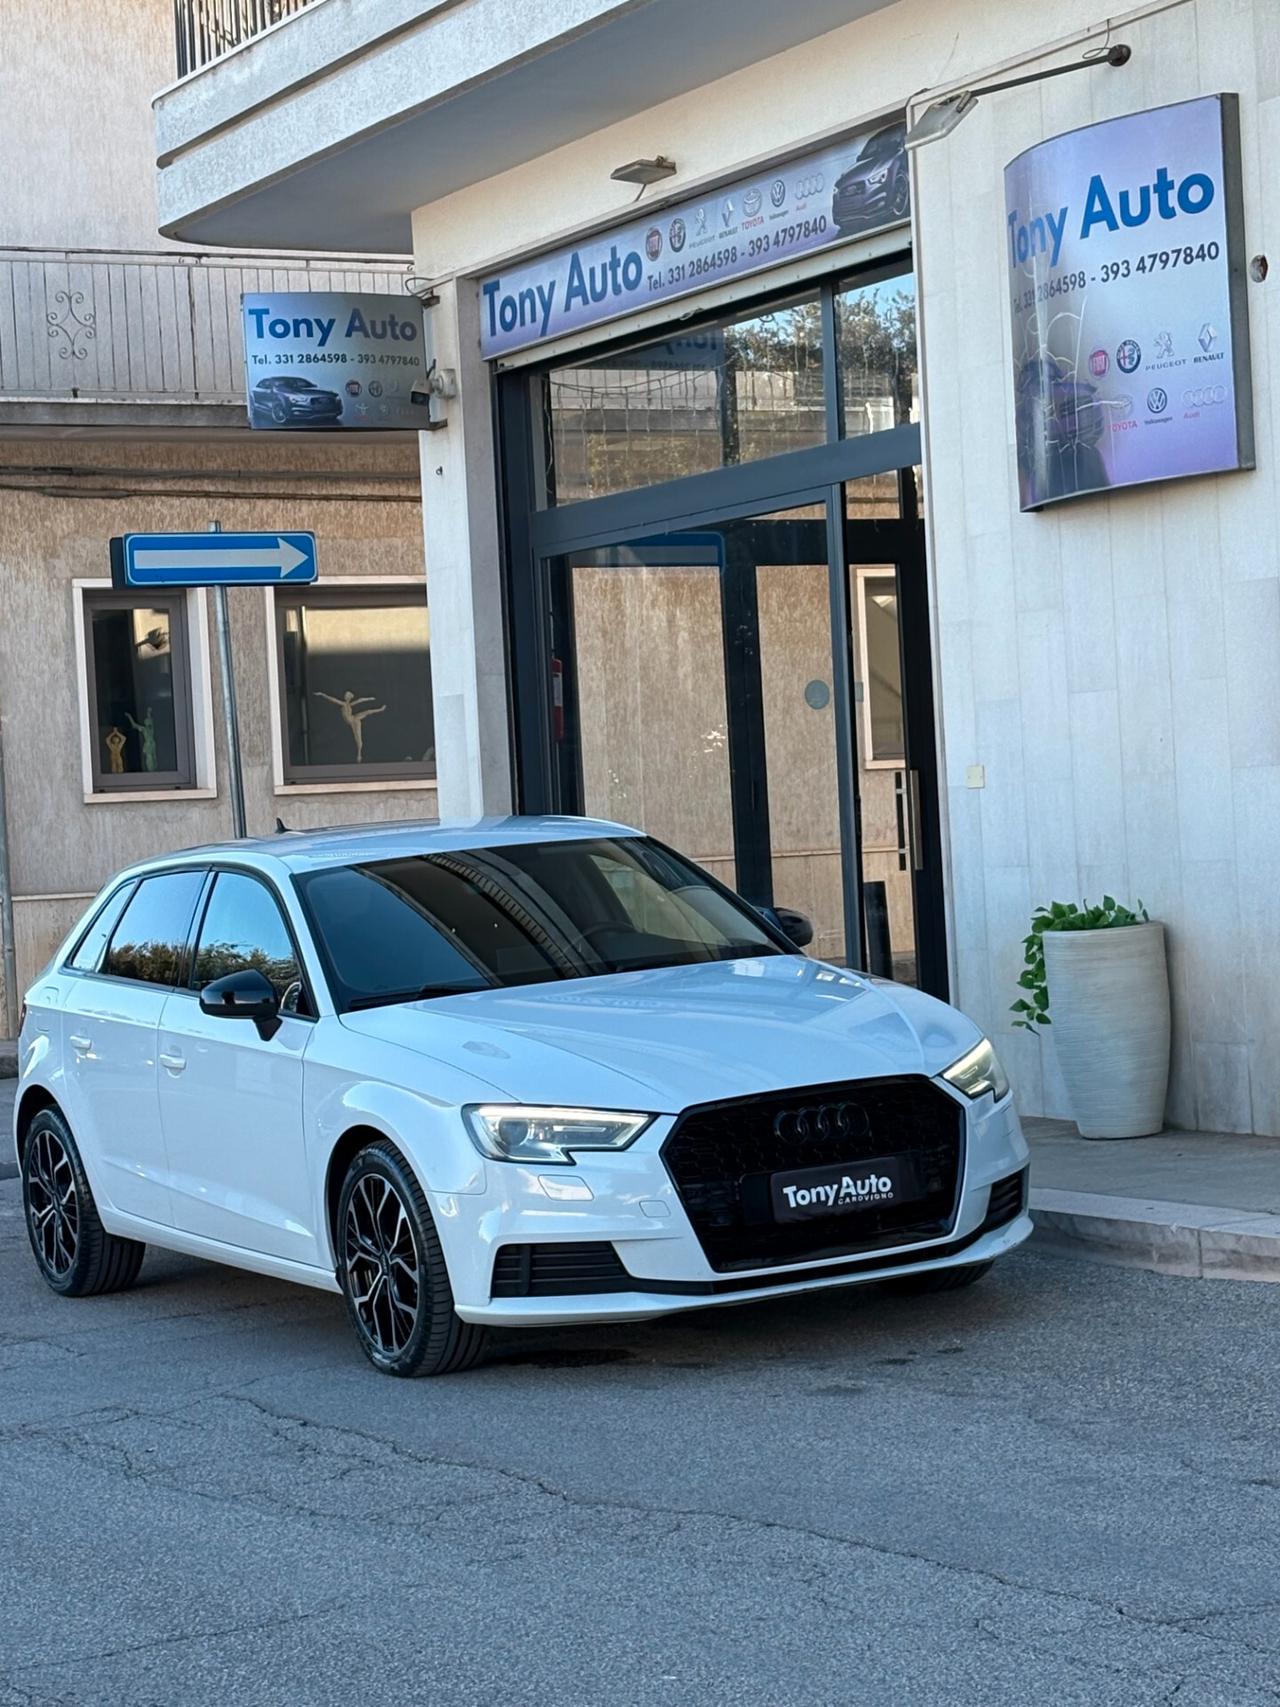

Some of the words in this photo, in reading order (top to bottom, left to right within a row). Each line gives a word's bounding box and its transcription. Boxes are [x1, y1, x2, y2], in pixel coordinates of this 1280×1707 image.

[741, 216, 764, 231] TOYOTA
[1008, 206, 1068, 268] Tony
[1080, 167, 1215, 240] Auto
[647, 274, 665, 291] Tel.
[668, 265, 685, 285] 331
[688, 247, 737, 277] 2864598
[748, 234, 770, 257] 393
[772, 215, 827, 248] 4797840
[1037, 270, 1086, 302] 2864598
[1100, 259, 1131, 283] 393
[1136, 241, 1220, 274] 4797840
[483, 279, 556, 337] Tony
[564, 245, 643, 312] Auto
[248, 308, 336, 347] Tony
[345, 308, 417, 341] Auto
[252, 355, 272, 365] Tel.
[275, 354, 294, 364] 331
[297, 353, 347, 364] 2864598
[357, 354, 377, 364] 393
[379, 355, 420, 366] 4797840
[1145, 358, 1187, 371] PEUGEOT
[1193, 352, 1225, 363] RENAULT
[783, 1174, 892, 1208] TonyAuto
[838, 1192, 894, 1205] CAROVIGNO
